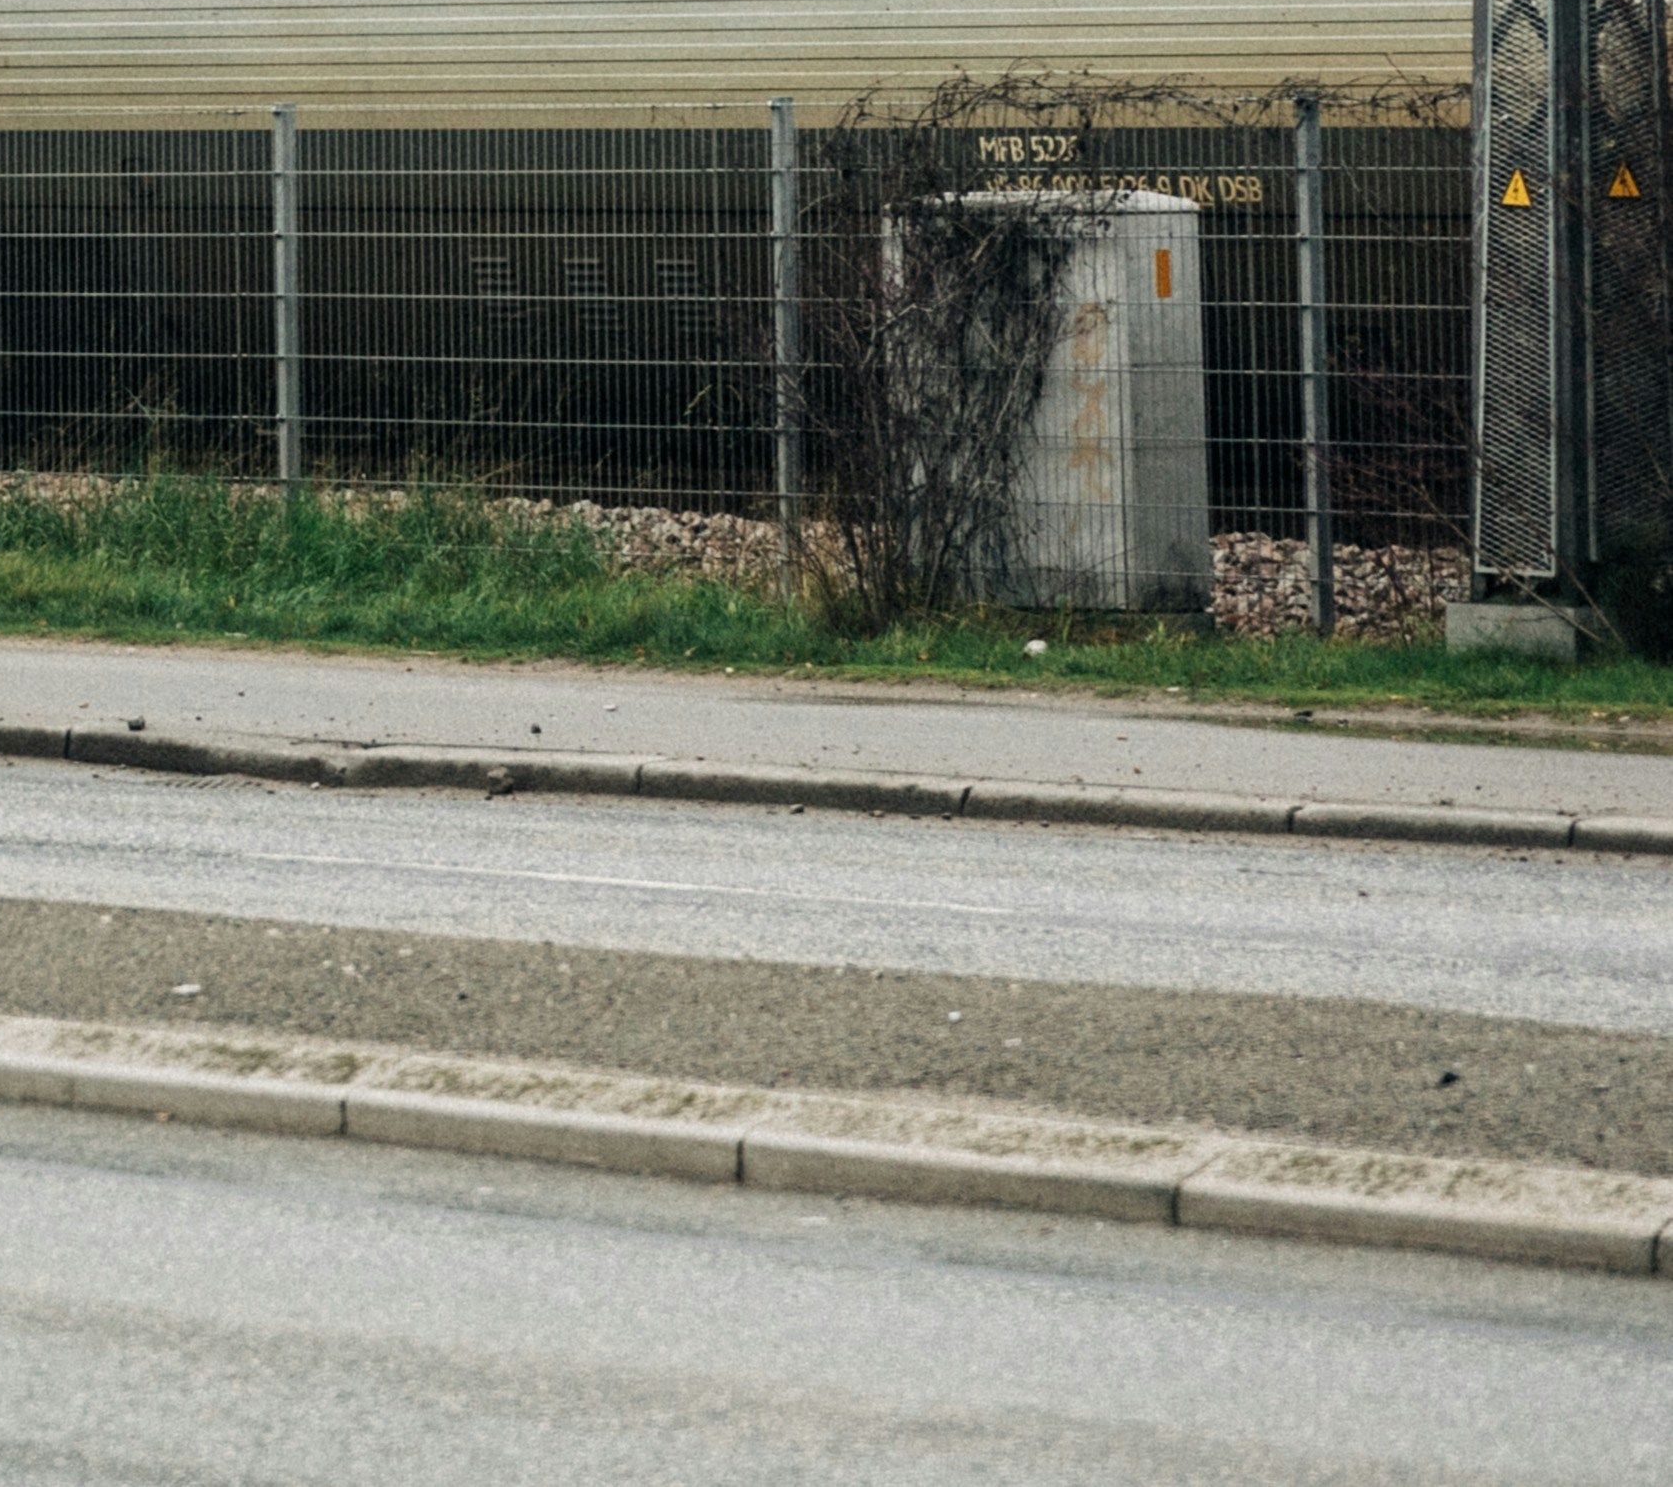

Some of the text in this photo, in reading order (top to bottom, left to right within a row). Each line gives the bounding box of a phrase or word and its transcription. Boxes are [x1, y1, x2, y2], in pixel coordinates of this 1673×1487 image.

[979, 135, 1025, 163] MFB
[1180, 176, 1214, 203] DK
[1218, 176, 1263, 203] DSB
